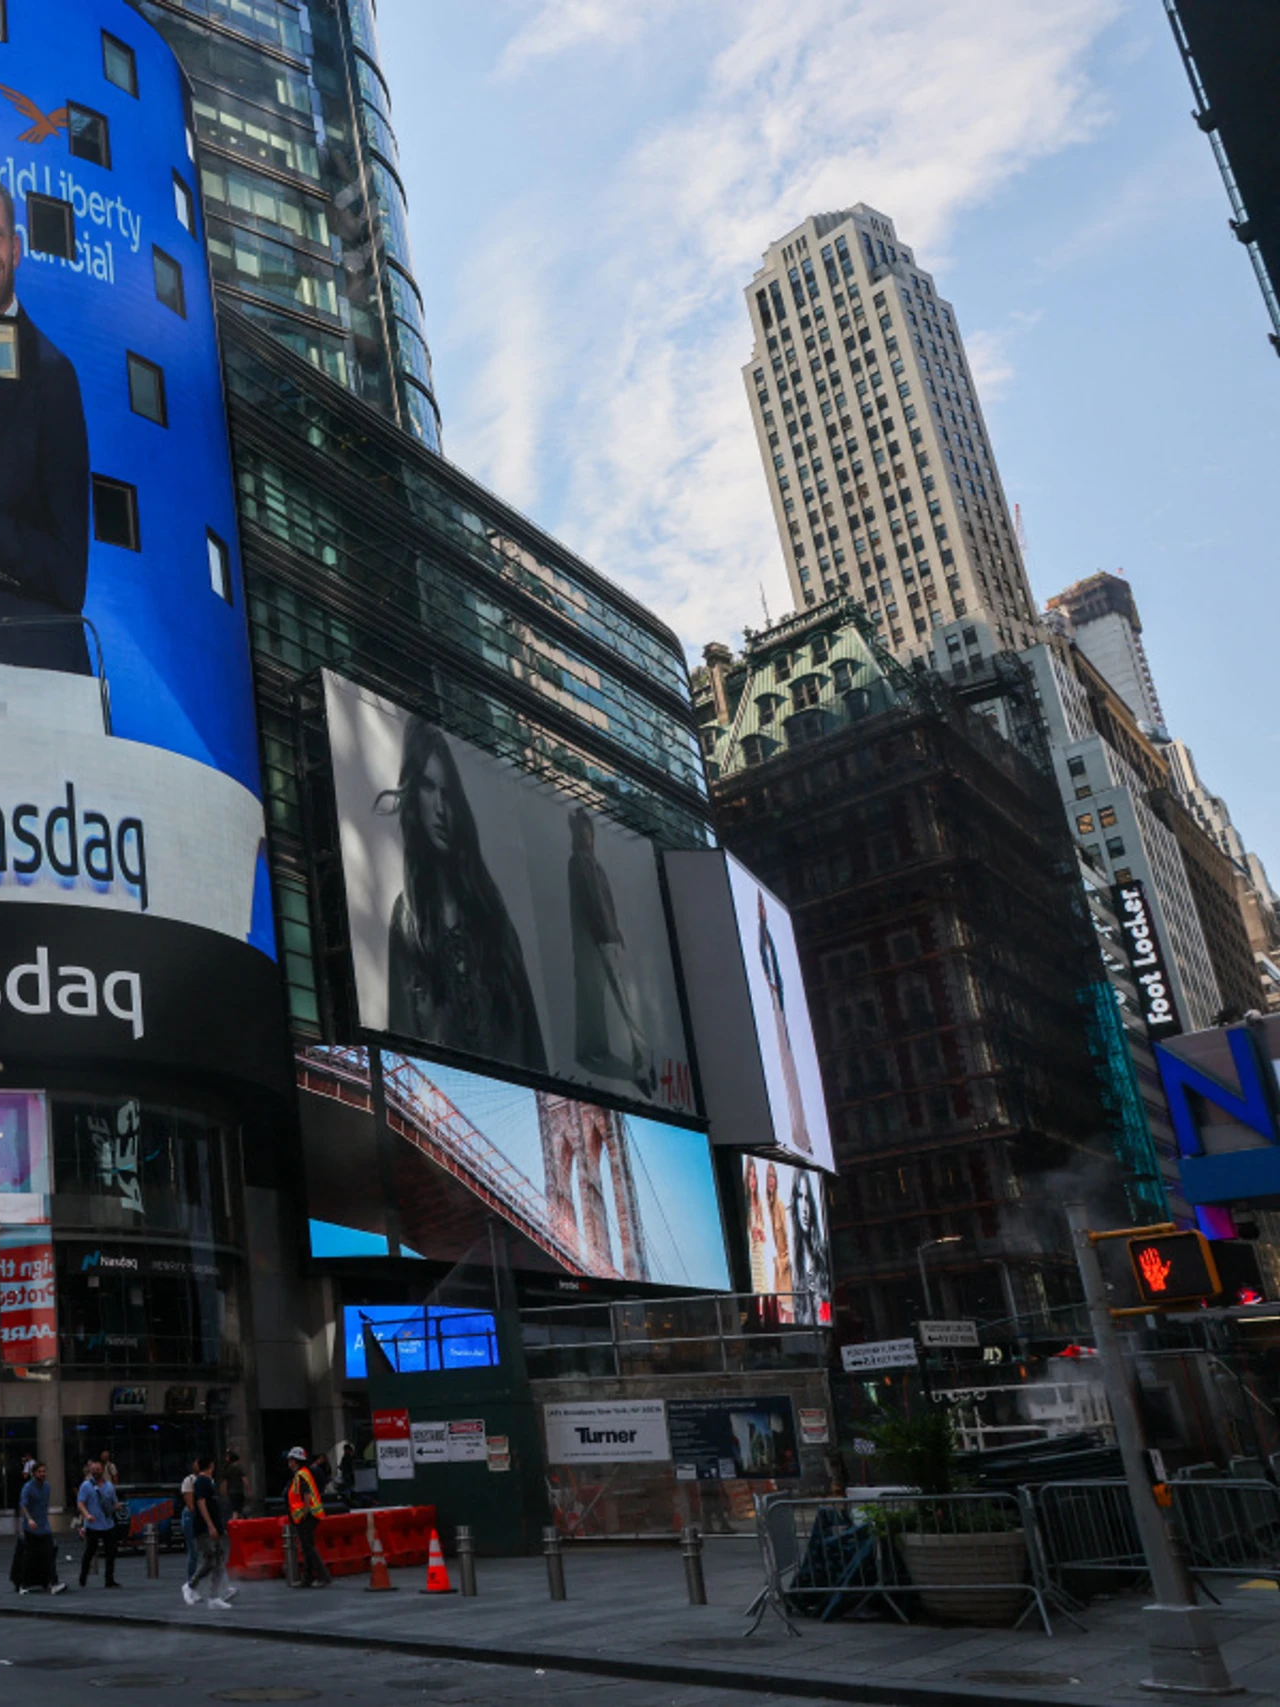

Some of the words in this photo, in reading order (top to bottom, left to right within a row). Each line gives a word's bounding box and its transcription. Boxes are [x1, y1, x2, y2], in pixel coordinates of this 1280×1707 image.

[1121, 888, 1158, 968] Locker
[1139, 970, 1174, 1025] Foot
[100, 1256, 138, 1270] Nasdaq
[575, 1427, 637, 1443] Turner
